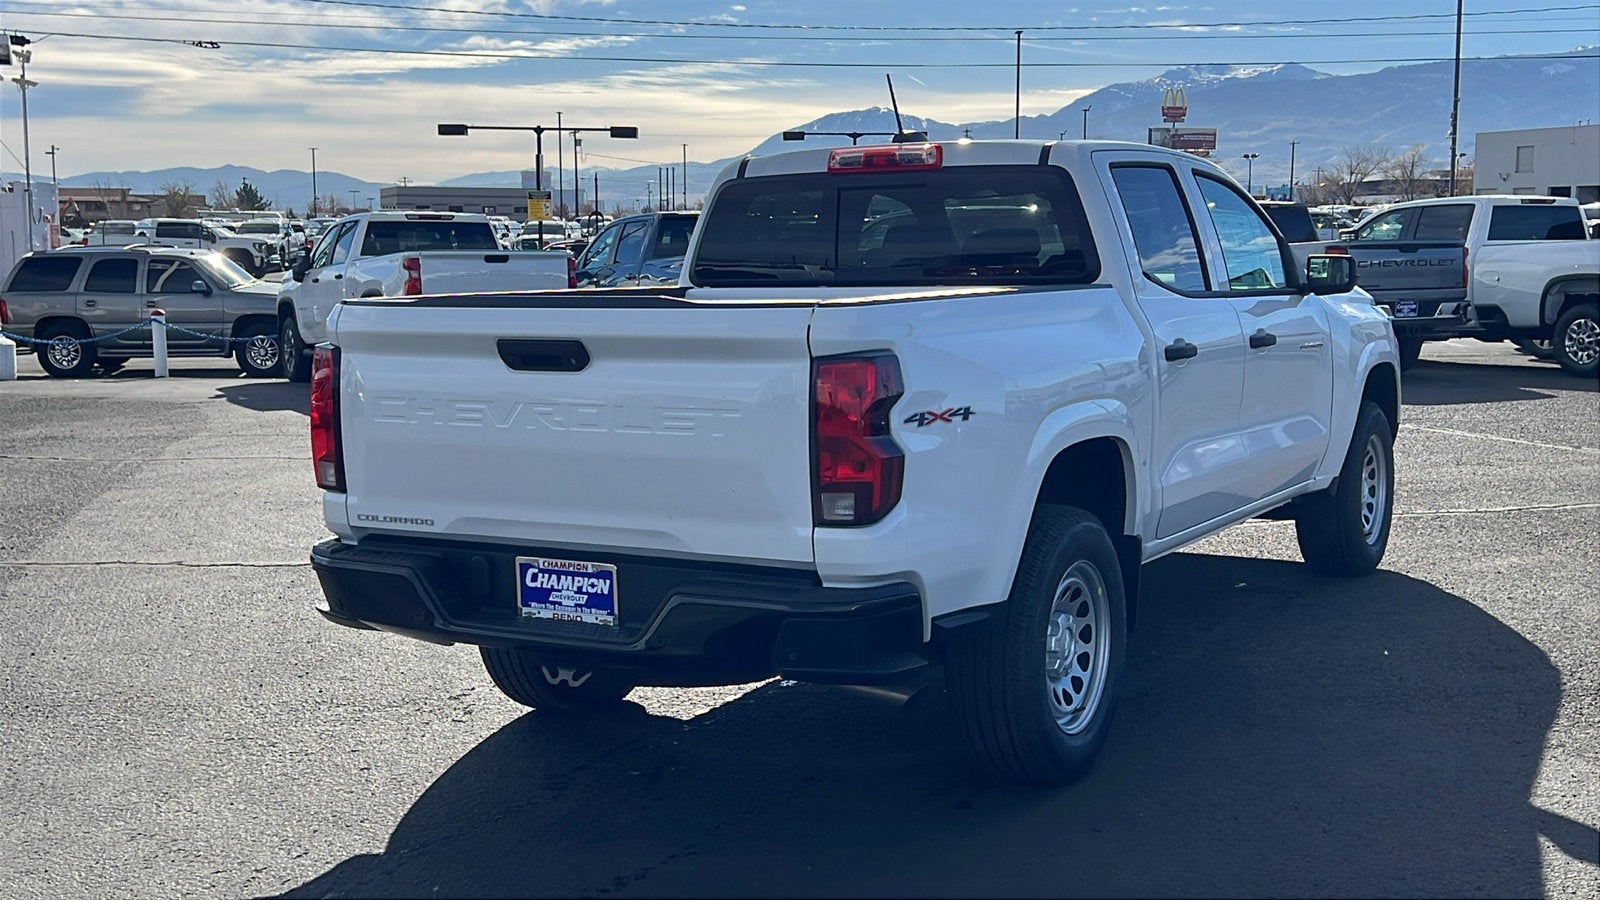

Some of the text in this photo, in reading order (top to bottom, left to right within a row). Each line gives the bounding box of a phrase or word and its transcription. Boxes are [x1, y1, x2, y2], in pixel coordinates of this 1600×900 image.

[1357, 258, 1456, 269] CHEVROLET
[374, 396, 742, 437] CHEVROLET
[357, 513, 435, 526] COLORADO
[542, 560, 589, 571] CHAMPION
[526, 568, 610, 594] CHAMPION
[551, 593, 585, 602] CHEVROLET
[552, 612, 583, 622] RENO
